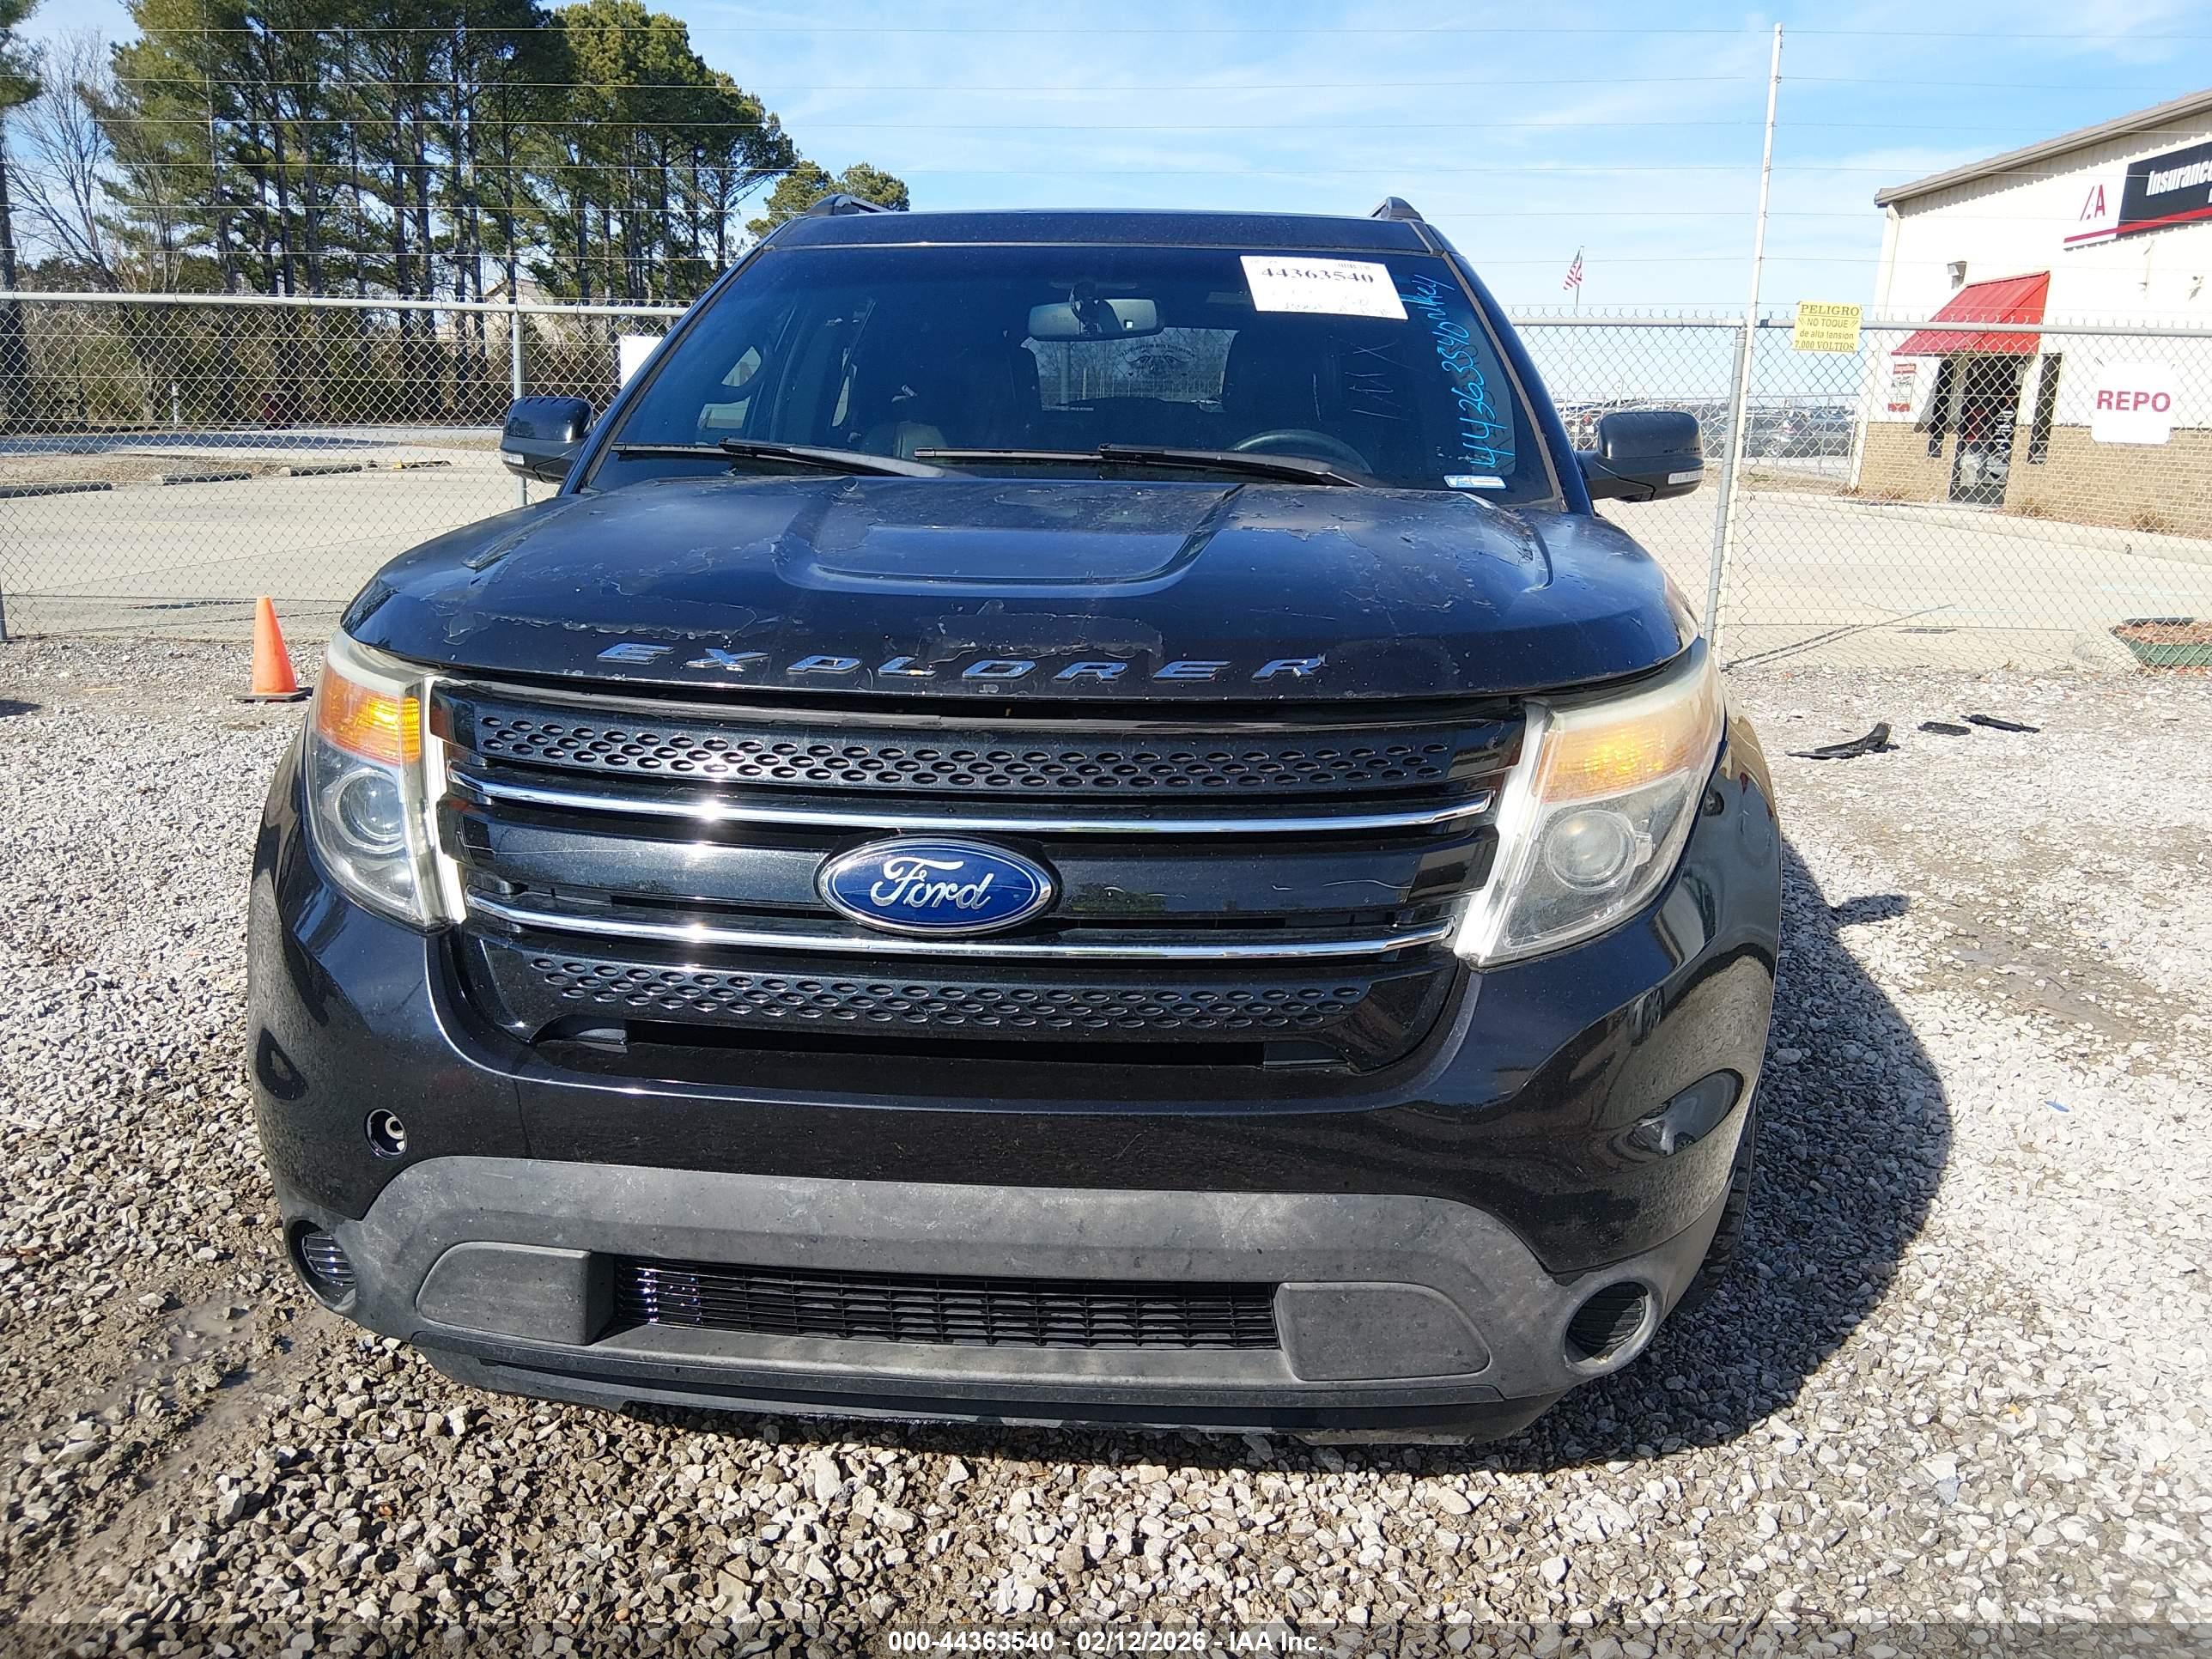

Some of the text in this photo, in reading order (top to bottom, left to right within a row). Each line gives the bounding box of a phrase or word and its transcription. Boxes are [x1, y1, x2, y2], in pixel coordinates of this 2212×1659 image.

[1261, 267, 1374, 284] 44363540
[1800, 304, 1860, 316] PELIGRO
[1807, 318, 1849, 328] NO TOQUE
[1799, 329, 1809, 337] de
[1817, 341, 1855, 351] VOLTIOS
[2096, 390, 2171, 413] REPO
[597, 642, 1328, 683] EXPLORER
[870, 857, 991, 910] Ford
